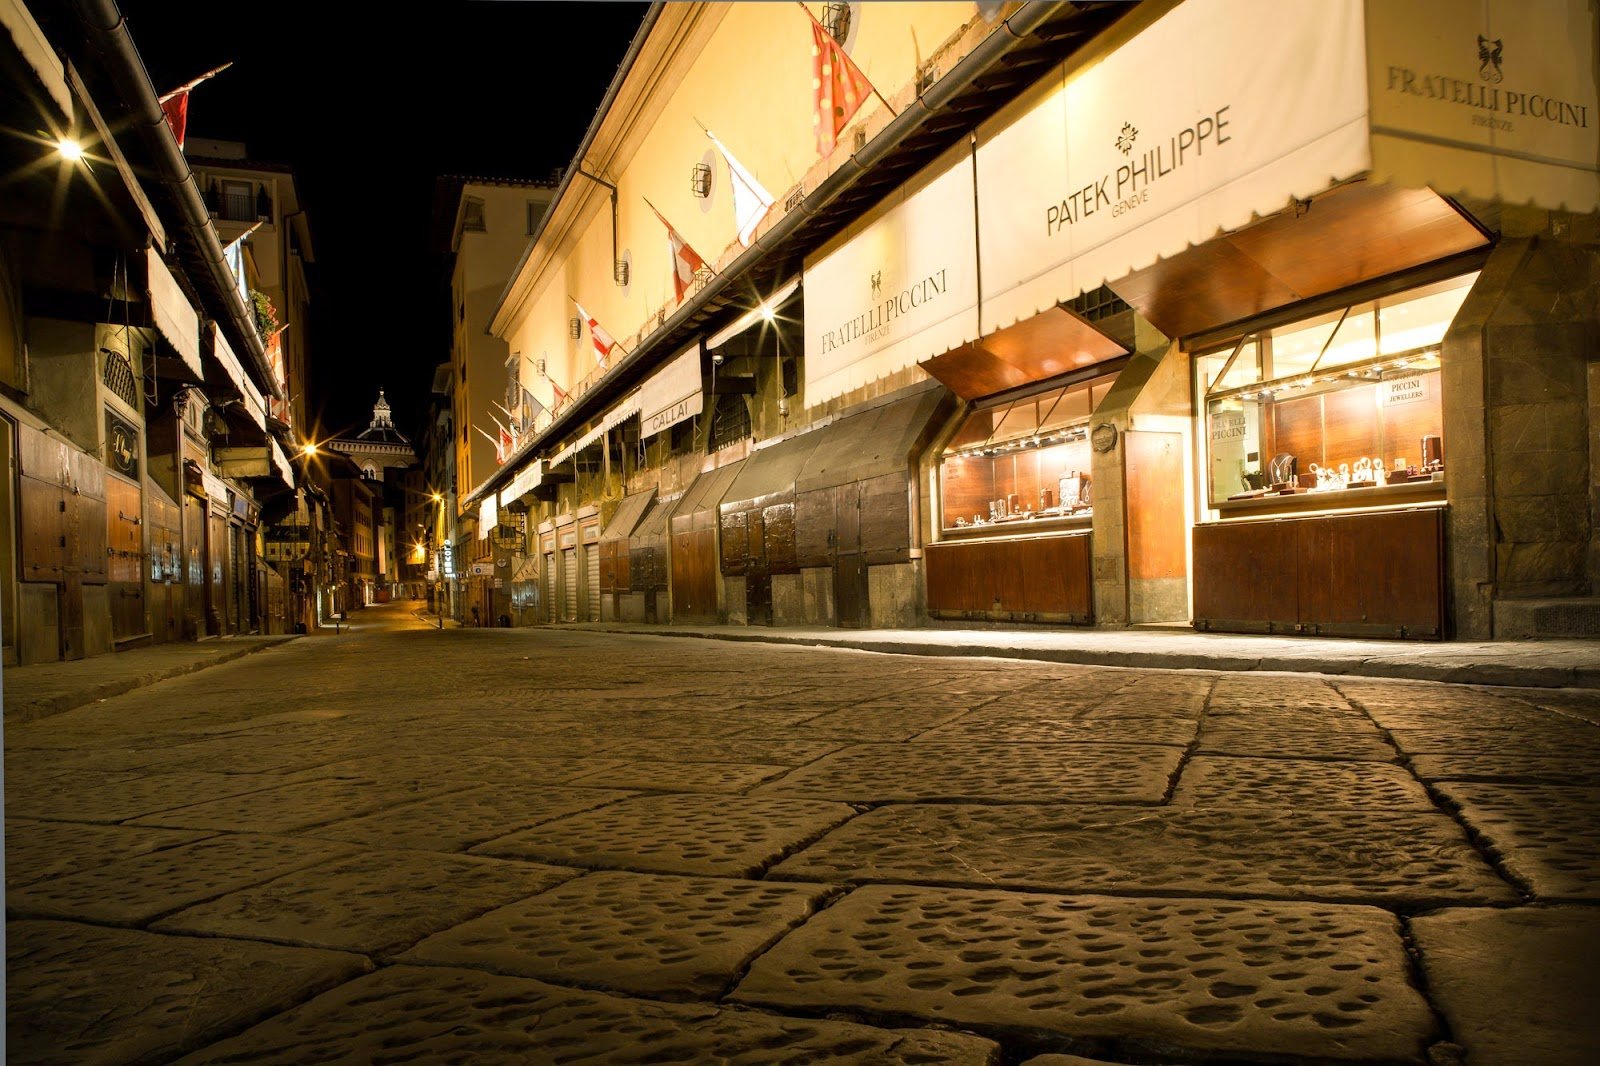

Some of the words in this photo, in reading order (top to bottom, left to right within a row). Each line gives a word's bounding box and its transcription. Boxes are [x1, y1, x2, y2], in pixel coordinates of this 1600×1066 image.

[1387, 66, 1500, 111] FRATELLI
[1505, 91, 1589, 128] PICCINI
[1046, 175, 1110, 237] PATEK
[1116, 104, 1232, 200] PHILIPPE
[821, 305, 882, 355] FRATELLI
[886, 268, 947, 322] PICCINI
[1390, 391, 1423, 402] JEWELLERS
[1391, 380, 1420, 392] PICCINI
[652, 402, 688, 430] CALLAI
[1213, 417, 1246, 429] RAELLI
[1212, 426, 1246, 440] PICCINI
